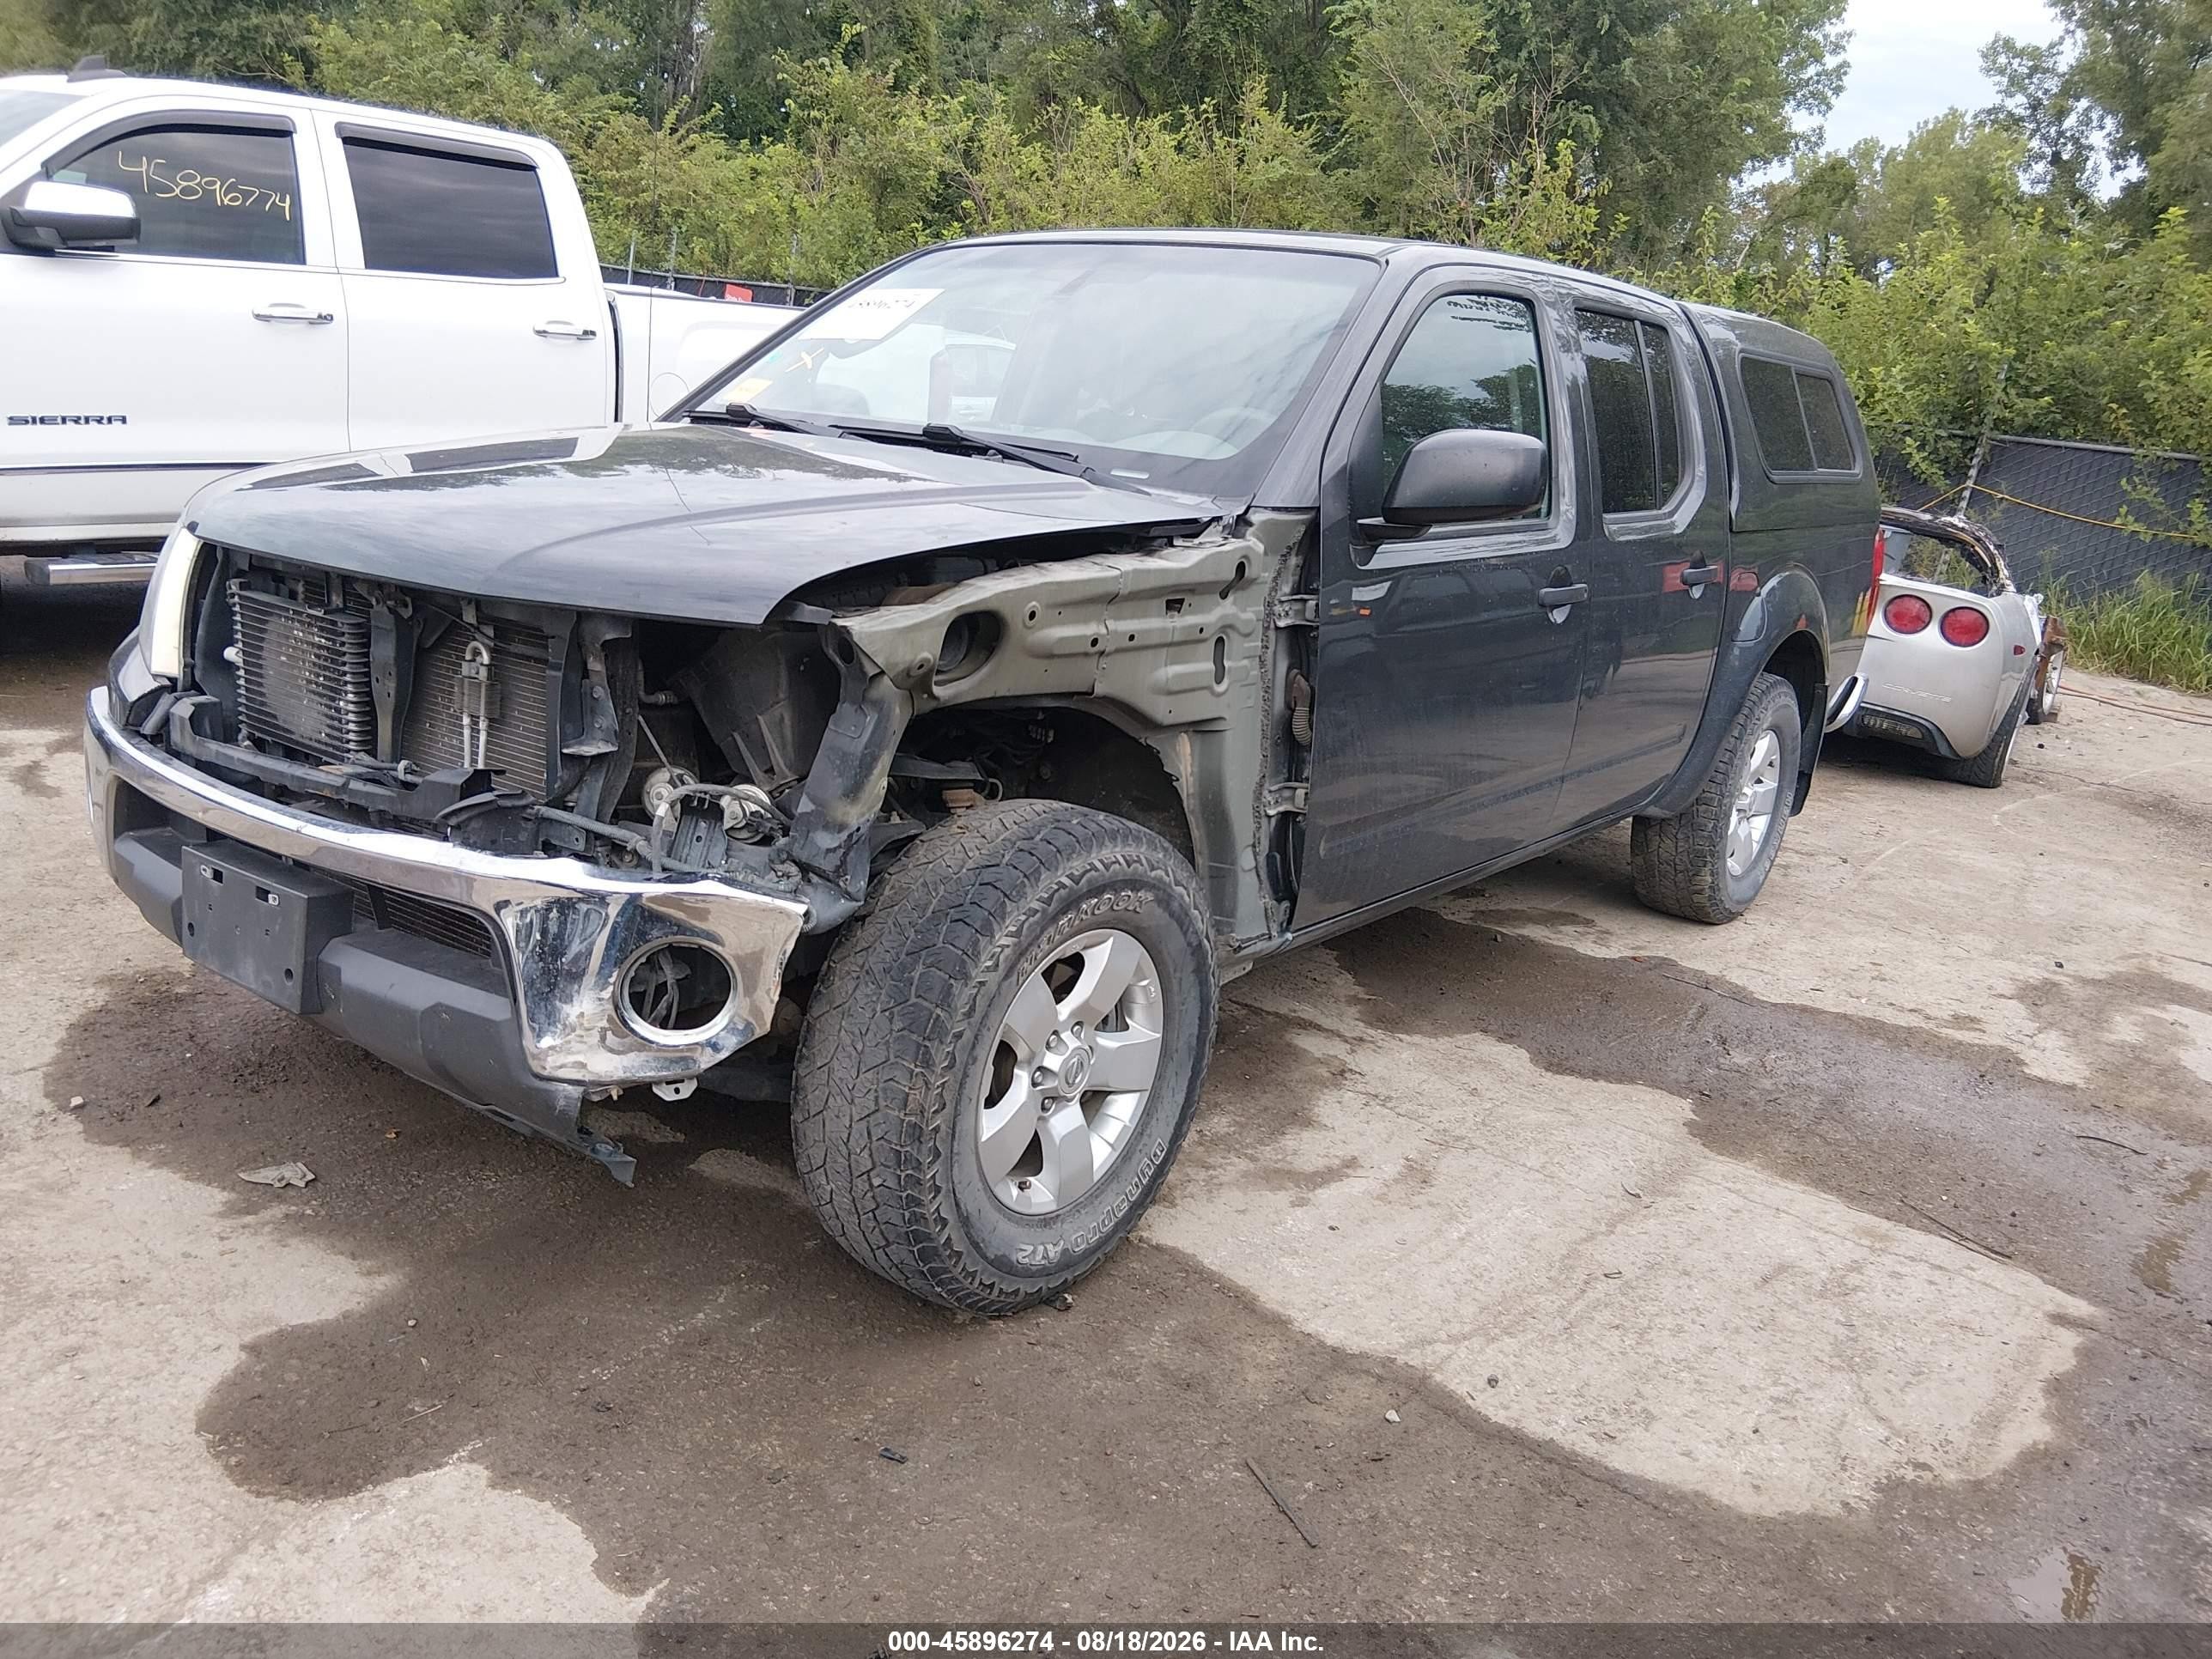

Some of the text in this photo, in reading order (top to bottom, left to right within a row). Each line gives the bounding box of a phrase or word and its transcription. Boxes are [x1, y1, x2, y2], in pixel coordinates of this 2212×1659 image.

[118, 150, 290, 221] 45896774
[7, 415, 127, 426] SIERRA
[1016, 1236, 1065, 1267] AT2
